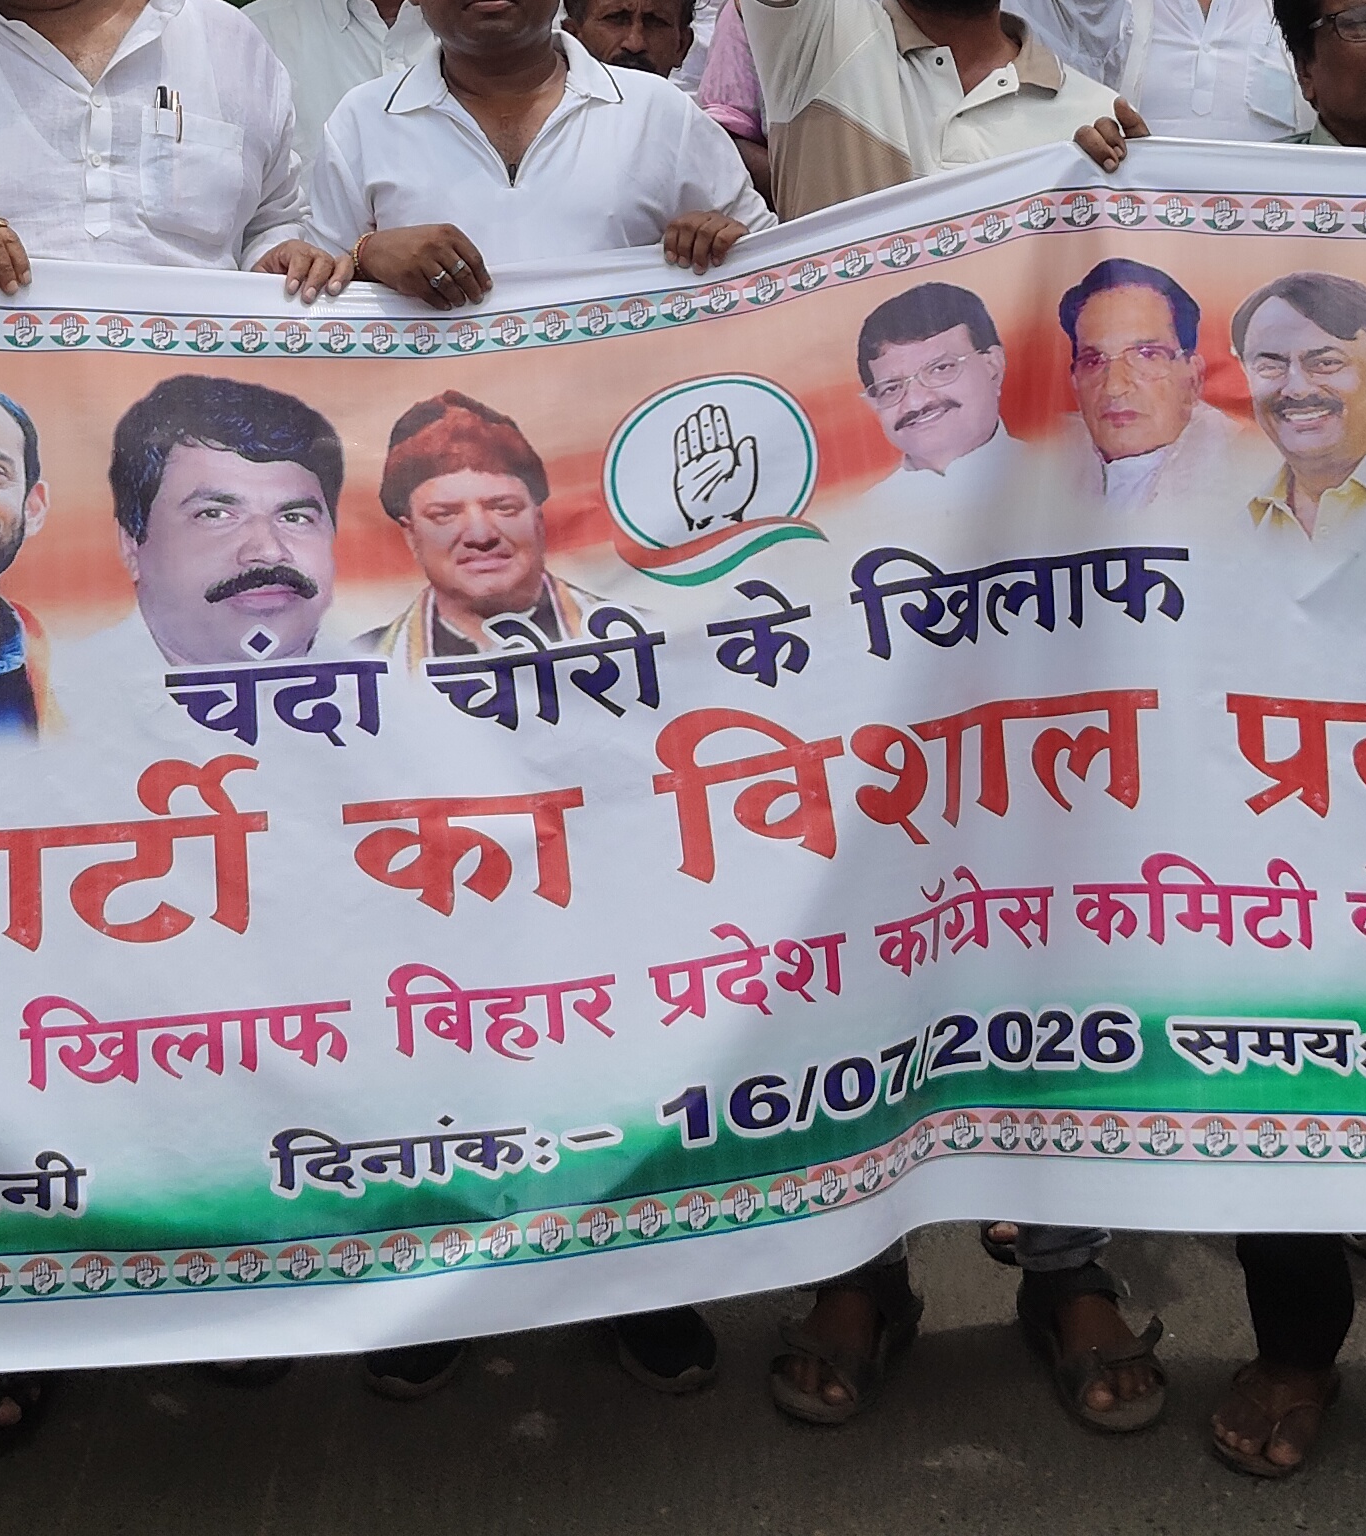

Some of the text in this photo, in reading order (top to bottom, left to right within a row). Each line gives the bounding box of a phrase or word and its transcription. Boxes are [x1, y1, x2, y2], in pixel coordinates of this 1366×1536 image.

[167, 547, 1189, 745] चंदा चोरी के खिलाफ
[343, 786, 584, 915] का
[653, 688, 1158, 885] विशाल
[20, 996, 352, 1090] खिलाफ
[387, 963, 615, 1061] बिहार
[649, 923, 847, 1027] प्रदेश
[1073, 852, 1317, 951] कमिटी
[661, 1010, 1137, 1142] 16/07/2026
